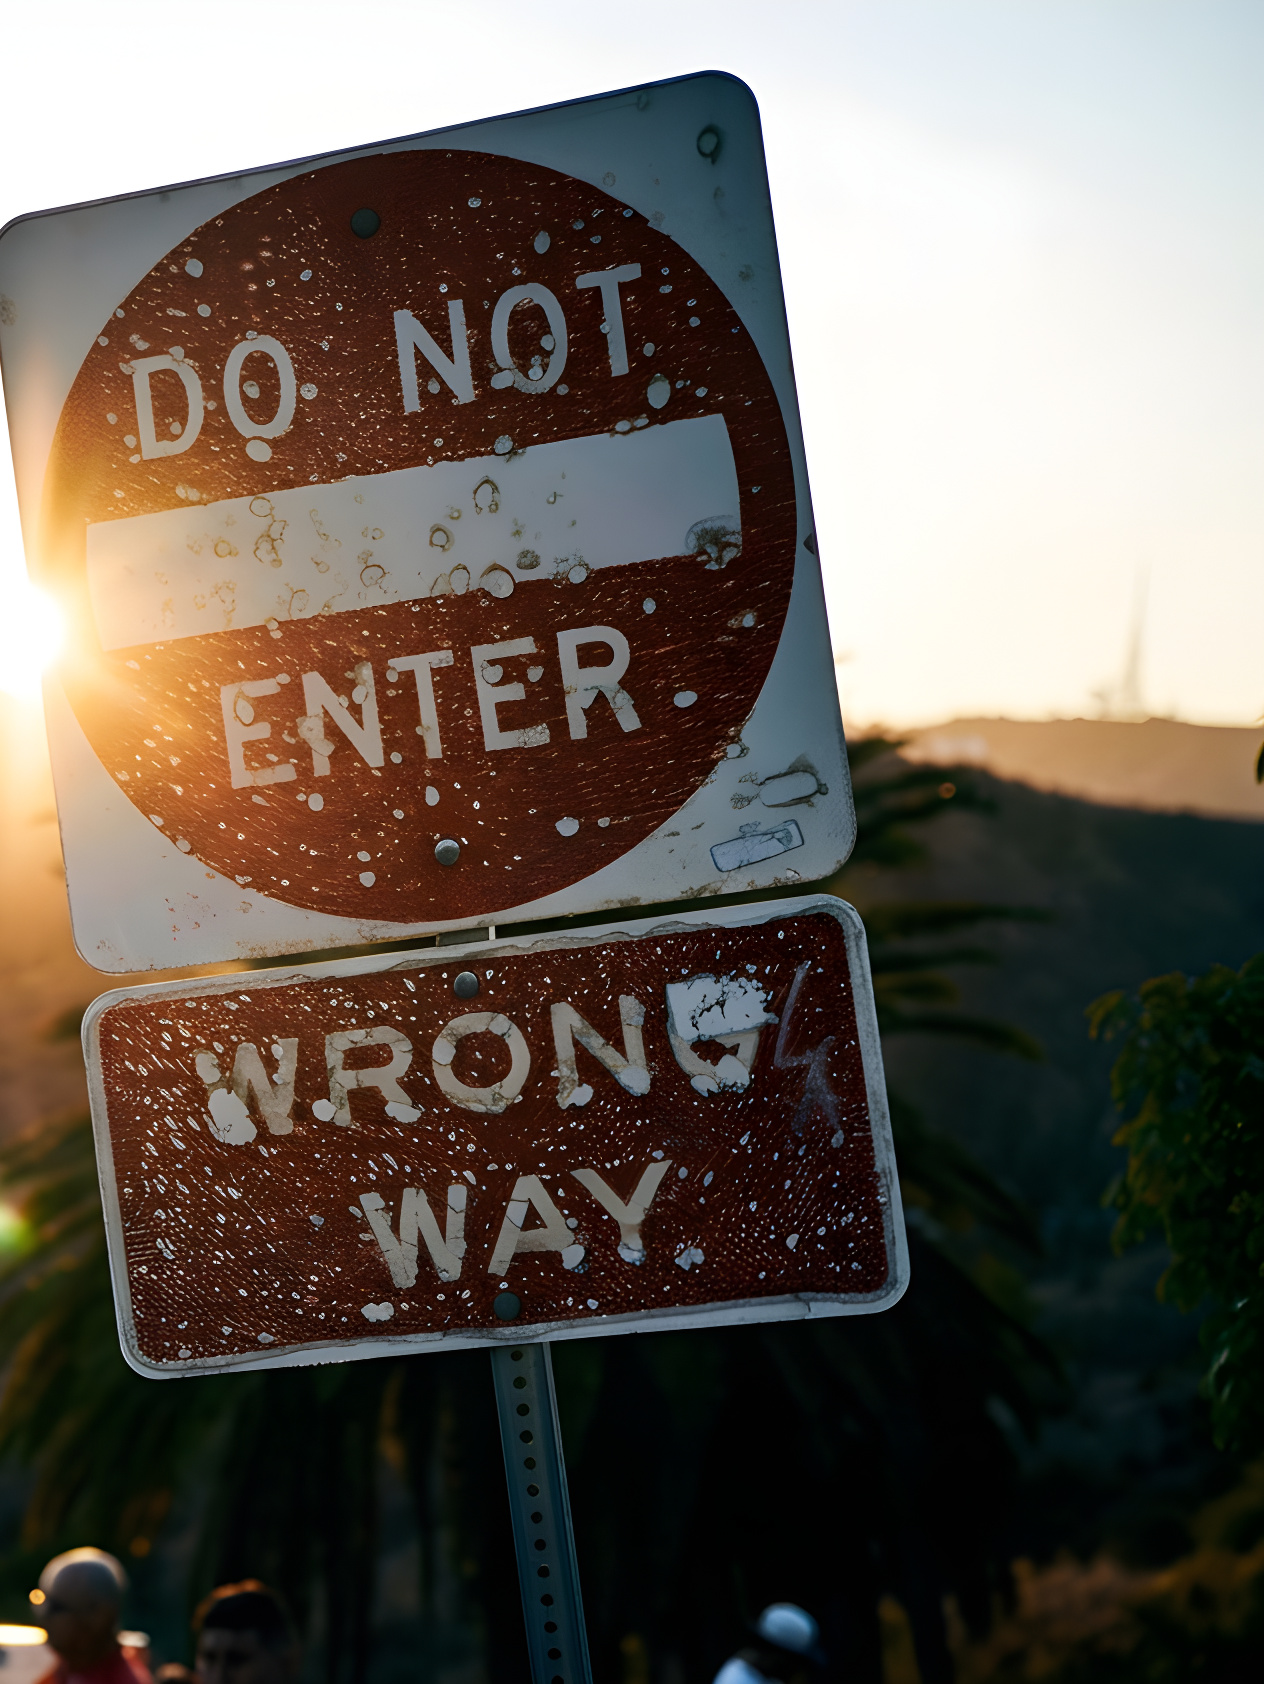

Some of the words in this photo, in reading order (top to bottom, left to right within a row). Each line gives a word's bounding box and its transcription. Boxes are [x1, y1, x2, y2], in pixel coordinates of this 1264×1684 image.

[132, 334, 298, 461] DO
[393, 263, 643, 414] NOT
[220, 625, 643, 790] ENTER
[360, 1160, 674, 1289] WAY
